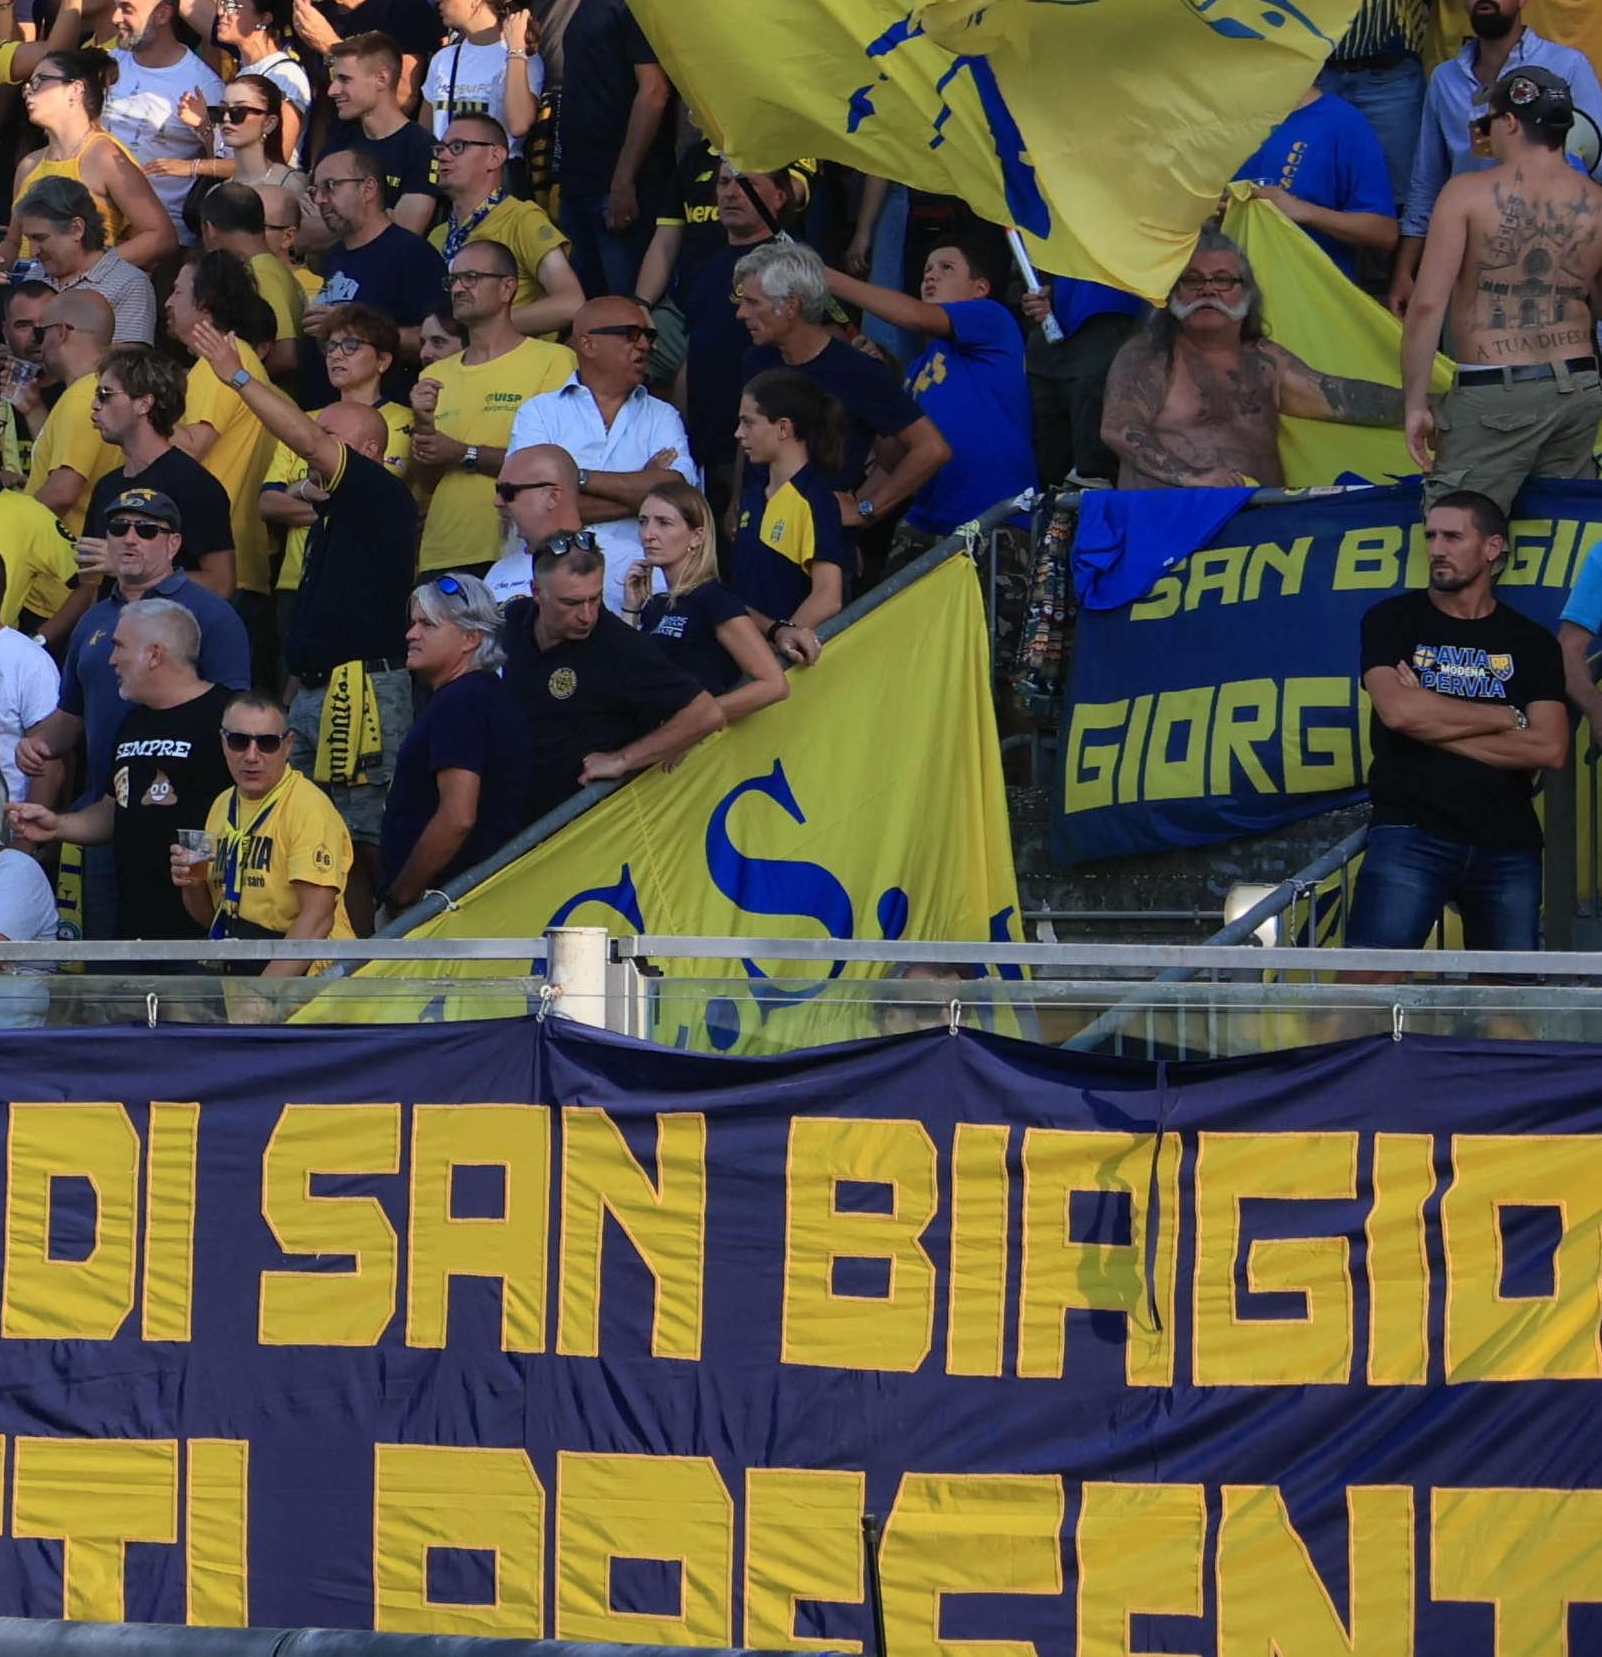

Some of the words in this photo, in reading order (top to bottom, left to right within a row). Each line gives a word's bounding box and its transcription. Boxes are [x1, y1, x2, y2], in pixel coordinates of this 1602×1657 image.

[1436, 645, 1488, 665] AVIA
[1422, 675, 1506, 698] PERVIA
[115, 739, 193, 760] SEMPRE
[1063, 677, 1373, 815] GIORG
[0, 1100, 200, 1341] DI
[258, 1102, 707, 1361] SAN
[780, 1115, 1602, 1387] BIAGIO
